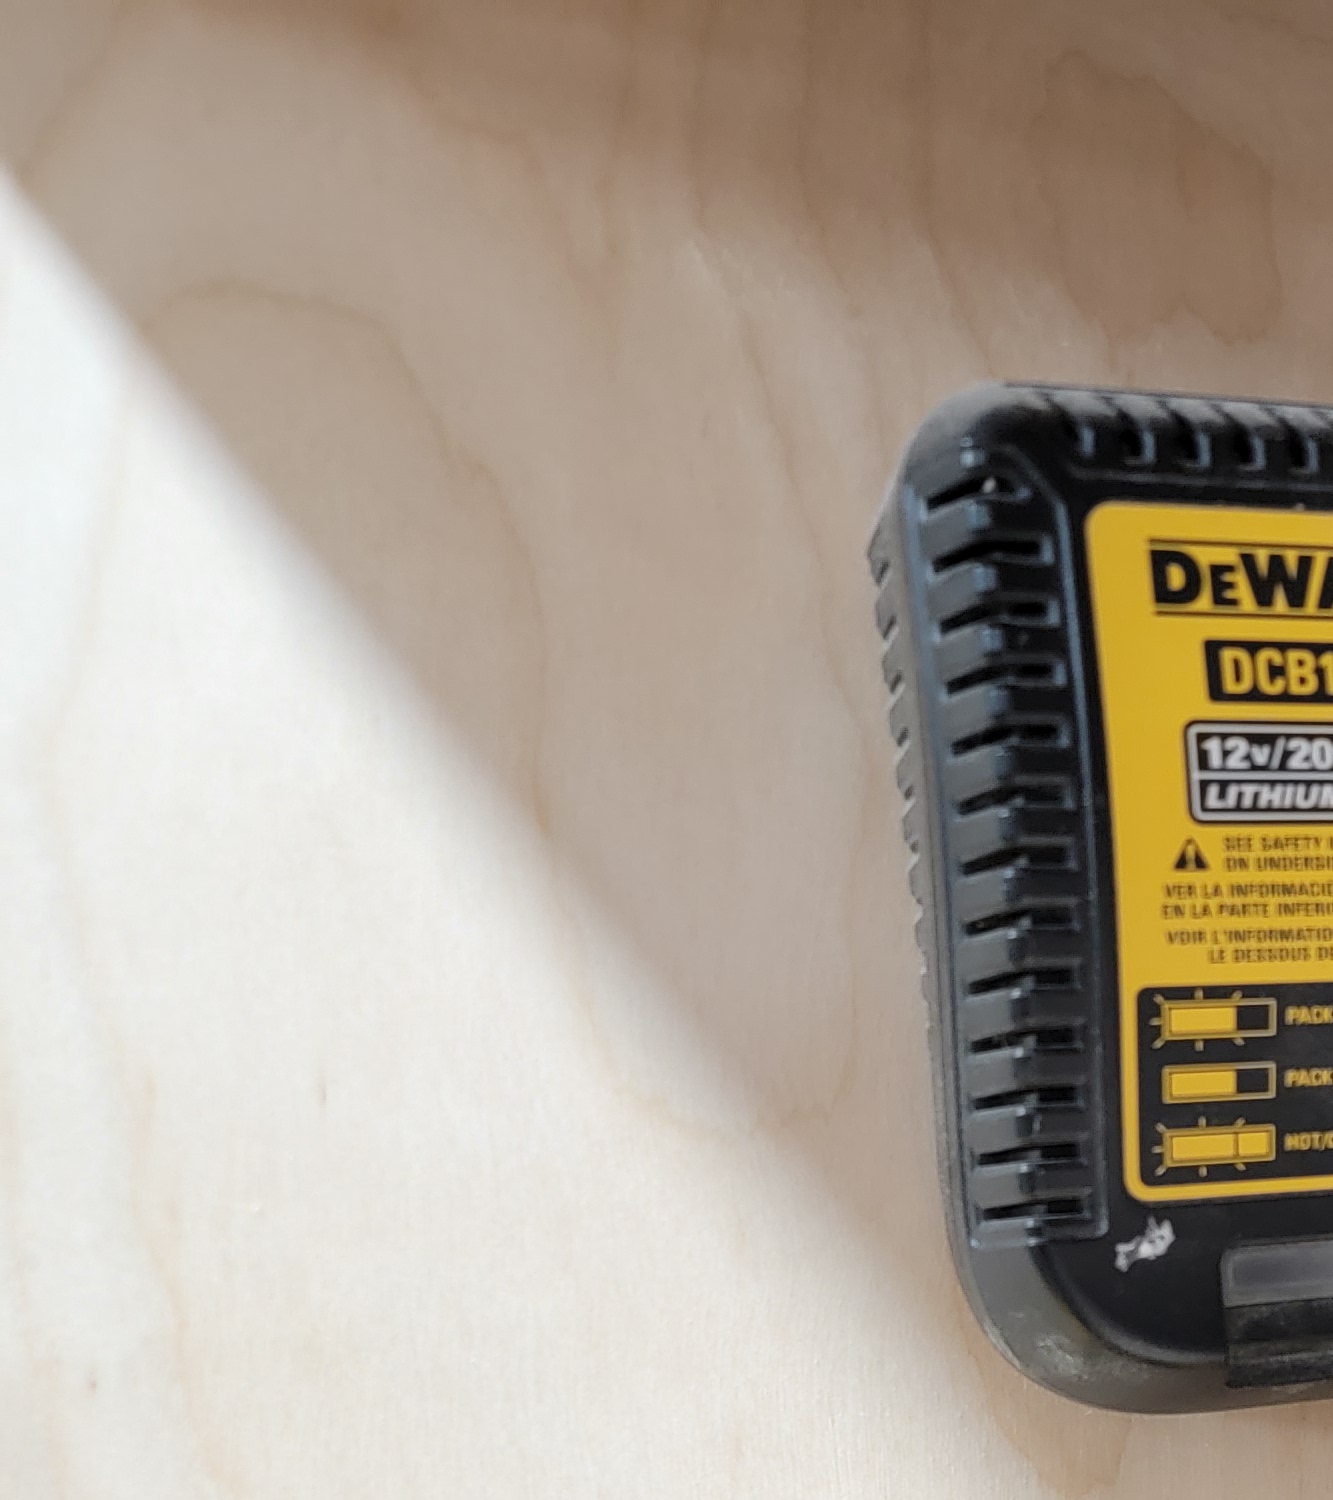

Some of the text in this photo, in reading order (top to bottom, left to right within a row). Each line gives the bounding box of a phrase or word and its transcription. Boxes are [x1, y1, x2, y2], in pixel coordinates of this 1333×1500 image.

[1224, 836, 1253, 852] SEE
[1261, 836, 1320, 852] SAFETY
[1225, 855, 1249, 871] ON
[1164, 884, 1196, 899] VER
[1203, 884, 1223, 898] LA
[1161, 904, 1185, 920] EN
[1192, 903, 1212, 919] LA
[1218, 903, 1271, 919] PARTE
[1165, 929, 1207, 945] VOIR
[1208, 948, 1227, 964] LE
[1234, 947, 1311, 963] DESSOUS
